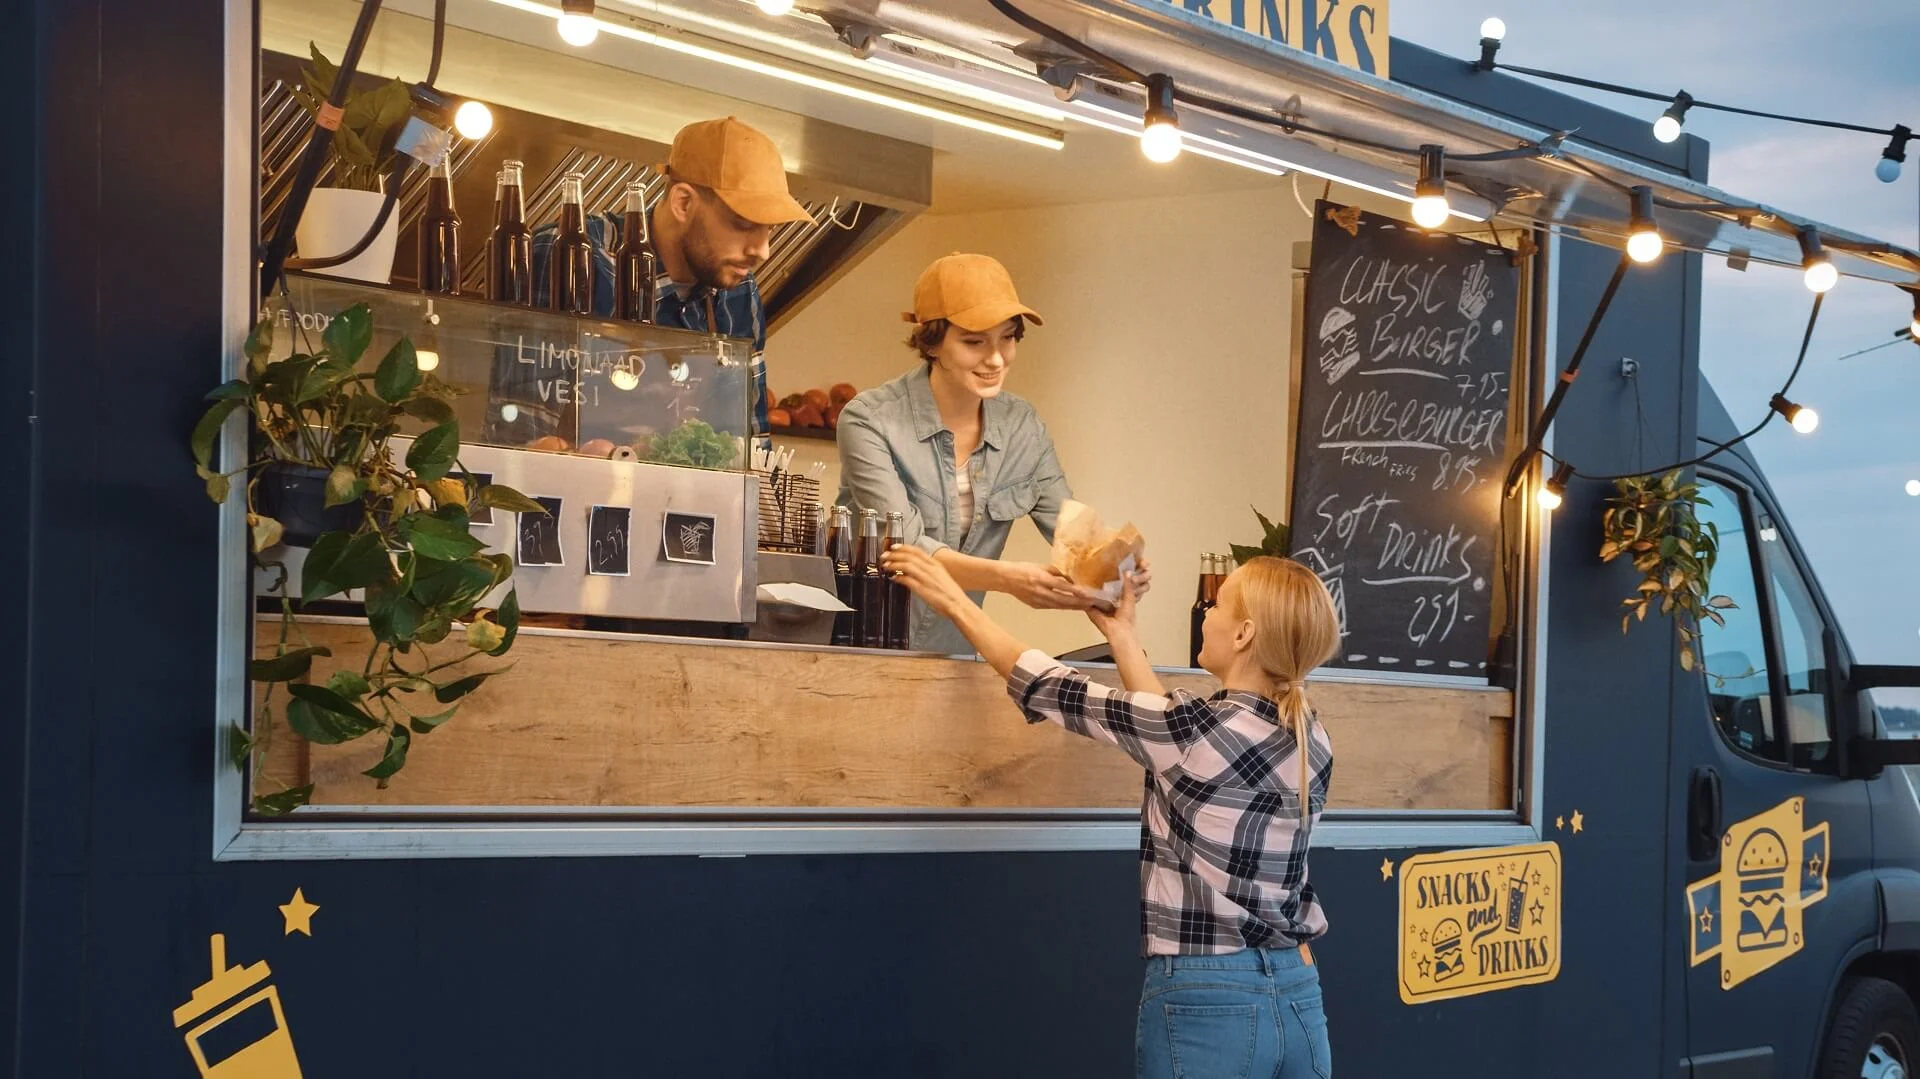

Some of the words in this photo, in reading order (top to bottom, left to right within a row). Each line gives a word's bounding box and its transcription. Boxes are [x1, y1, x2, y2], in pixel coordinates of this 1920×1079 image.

[1369, 312, 1481, 366] BURGER
[537, 379, 600, 407] VESI
[1416, 869, 1491, 909] SNACKS
[1467, 888, 1502, 938] and
[1478, 935, 1549, 977] DRINKS
